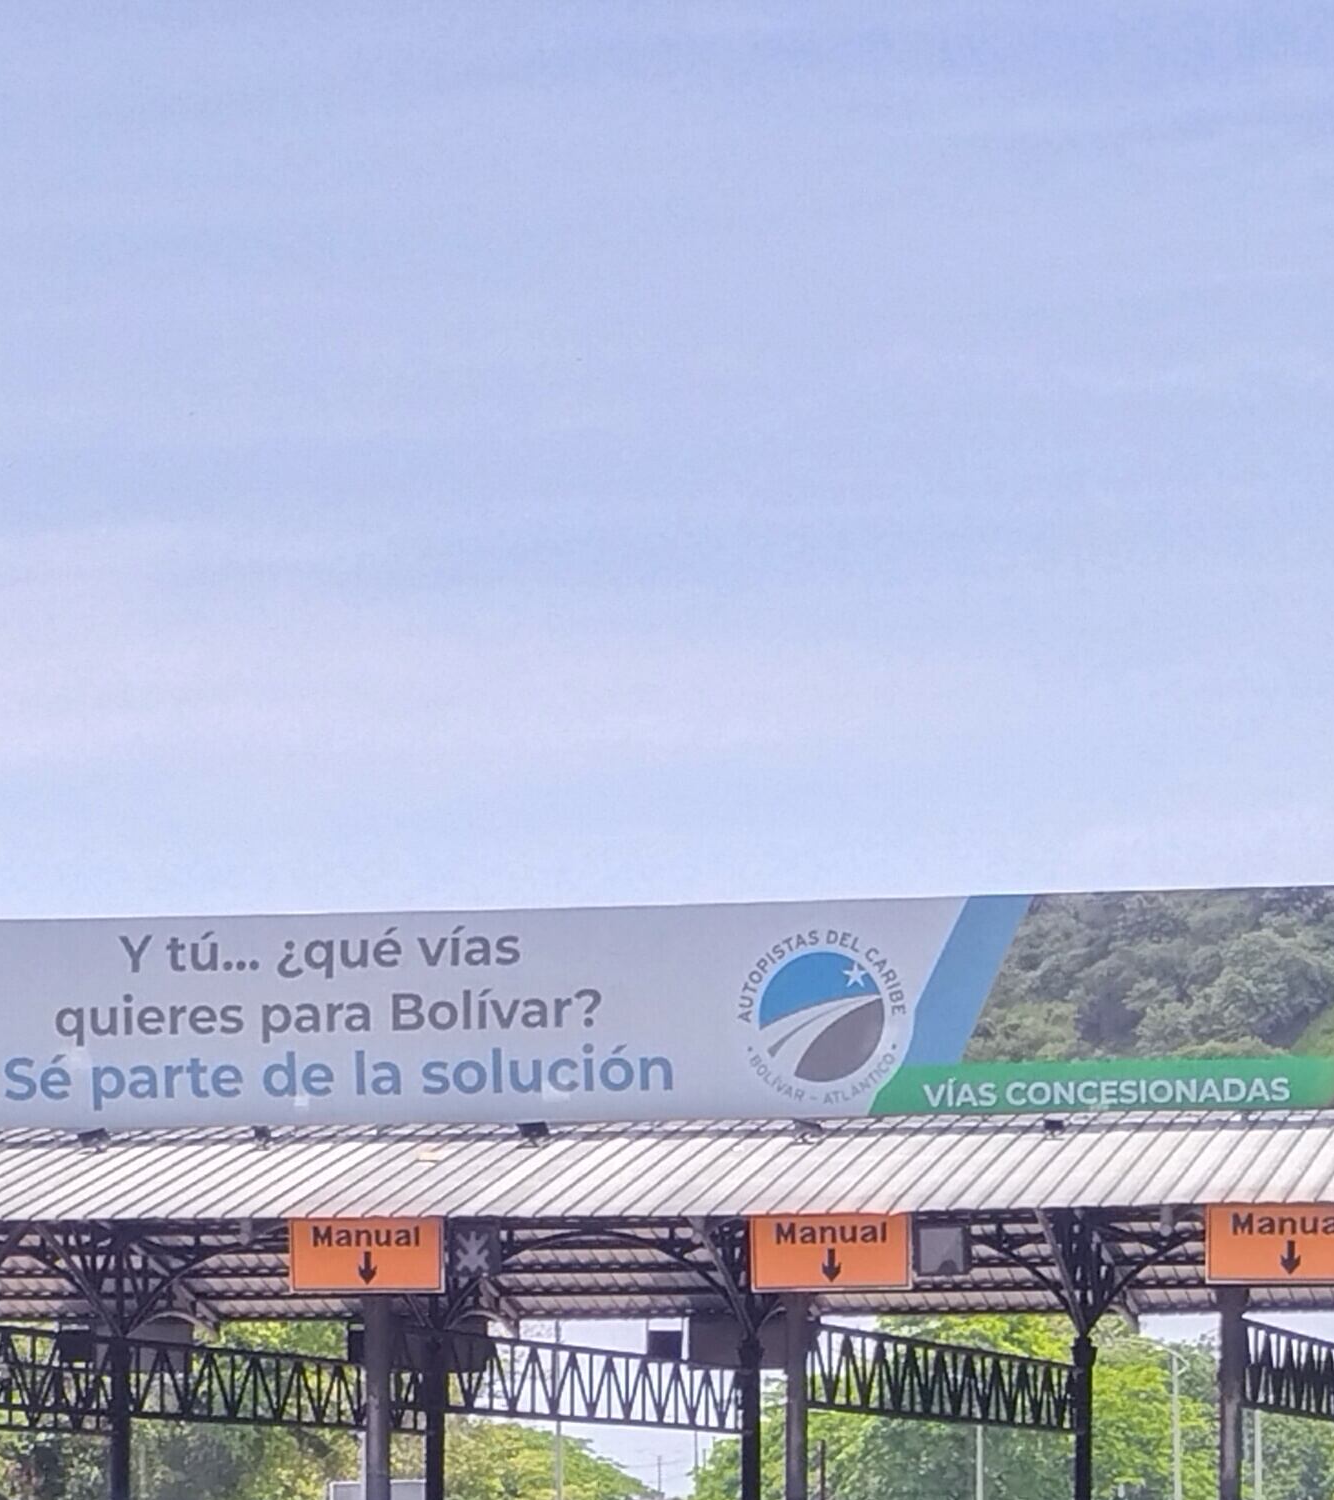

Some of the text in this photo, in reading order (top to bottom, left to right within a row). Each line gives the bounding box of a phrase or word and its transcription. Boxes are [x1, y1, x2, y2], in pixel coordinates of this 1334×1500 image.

[119, 934, 153, 972] Y
[276, 927, 403, 979] ¿qué
[417, 925, 520, 967] vías
[737, 929, 907, 1024] AUTOPISTAS DEL CARIBE
[55, 988, 603, 1046] quieres para Bolívar?
[4, 1043, 674, 1111] Sé parte de la solución
[923, 1077, 1291, 1107] VÍAS CONCESIONADAS
[312, 1226, 420, 1247] Manual
[775, 1221, 887, 1245] Manual
